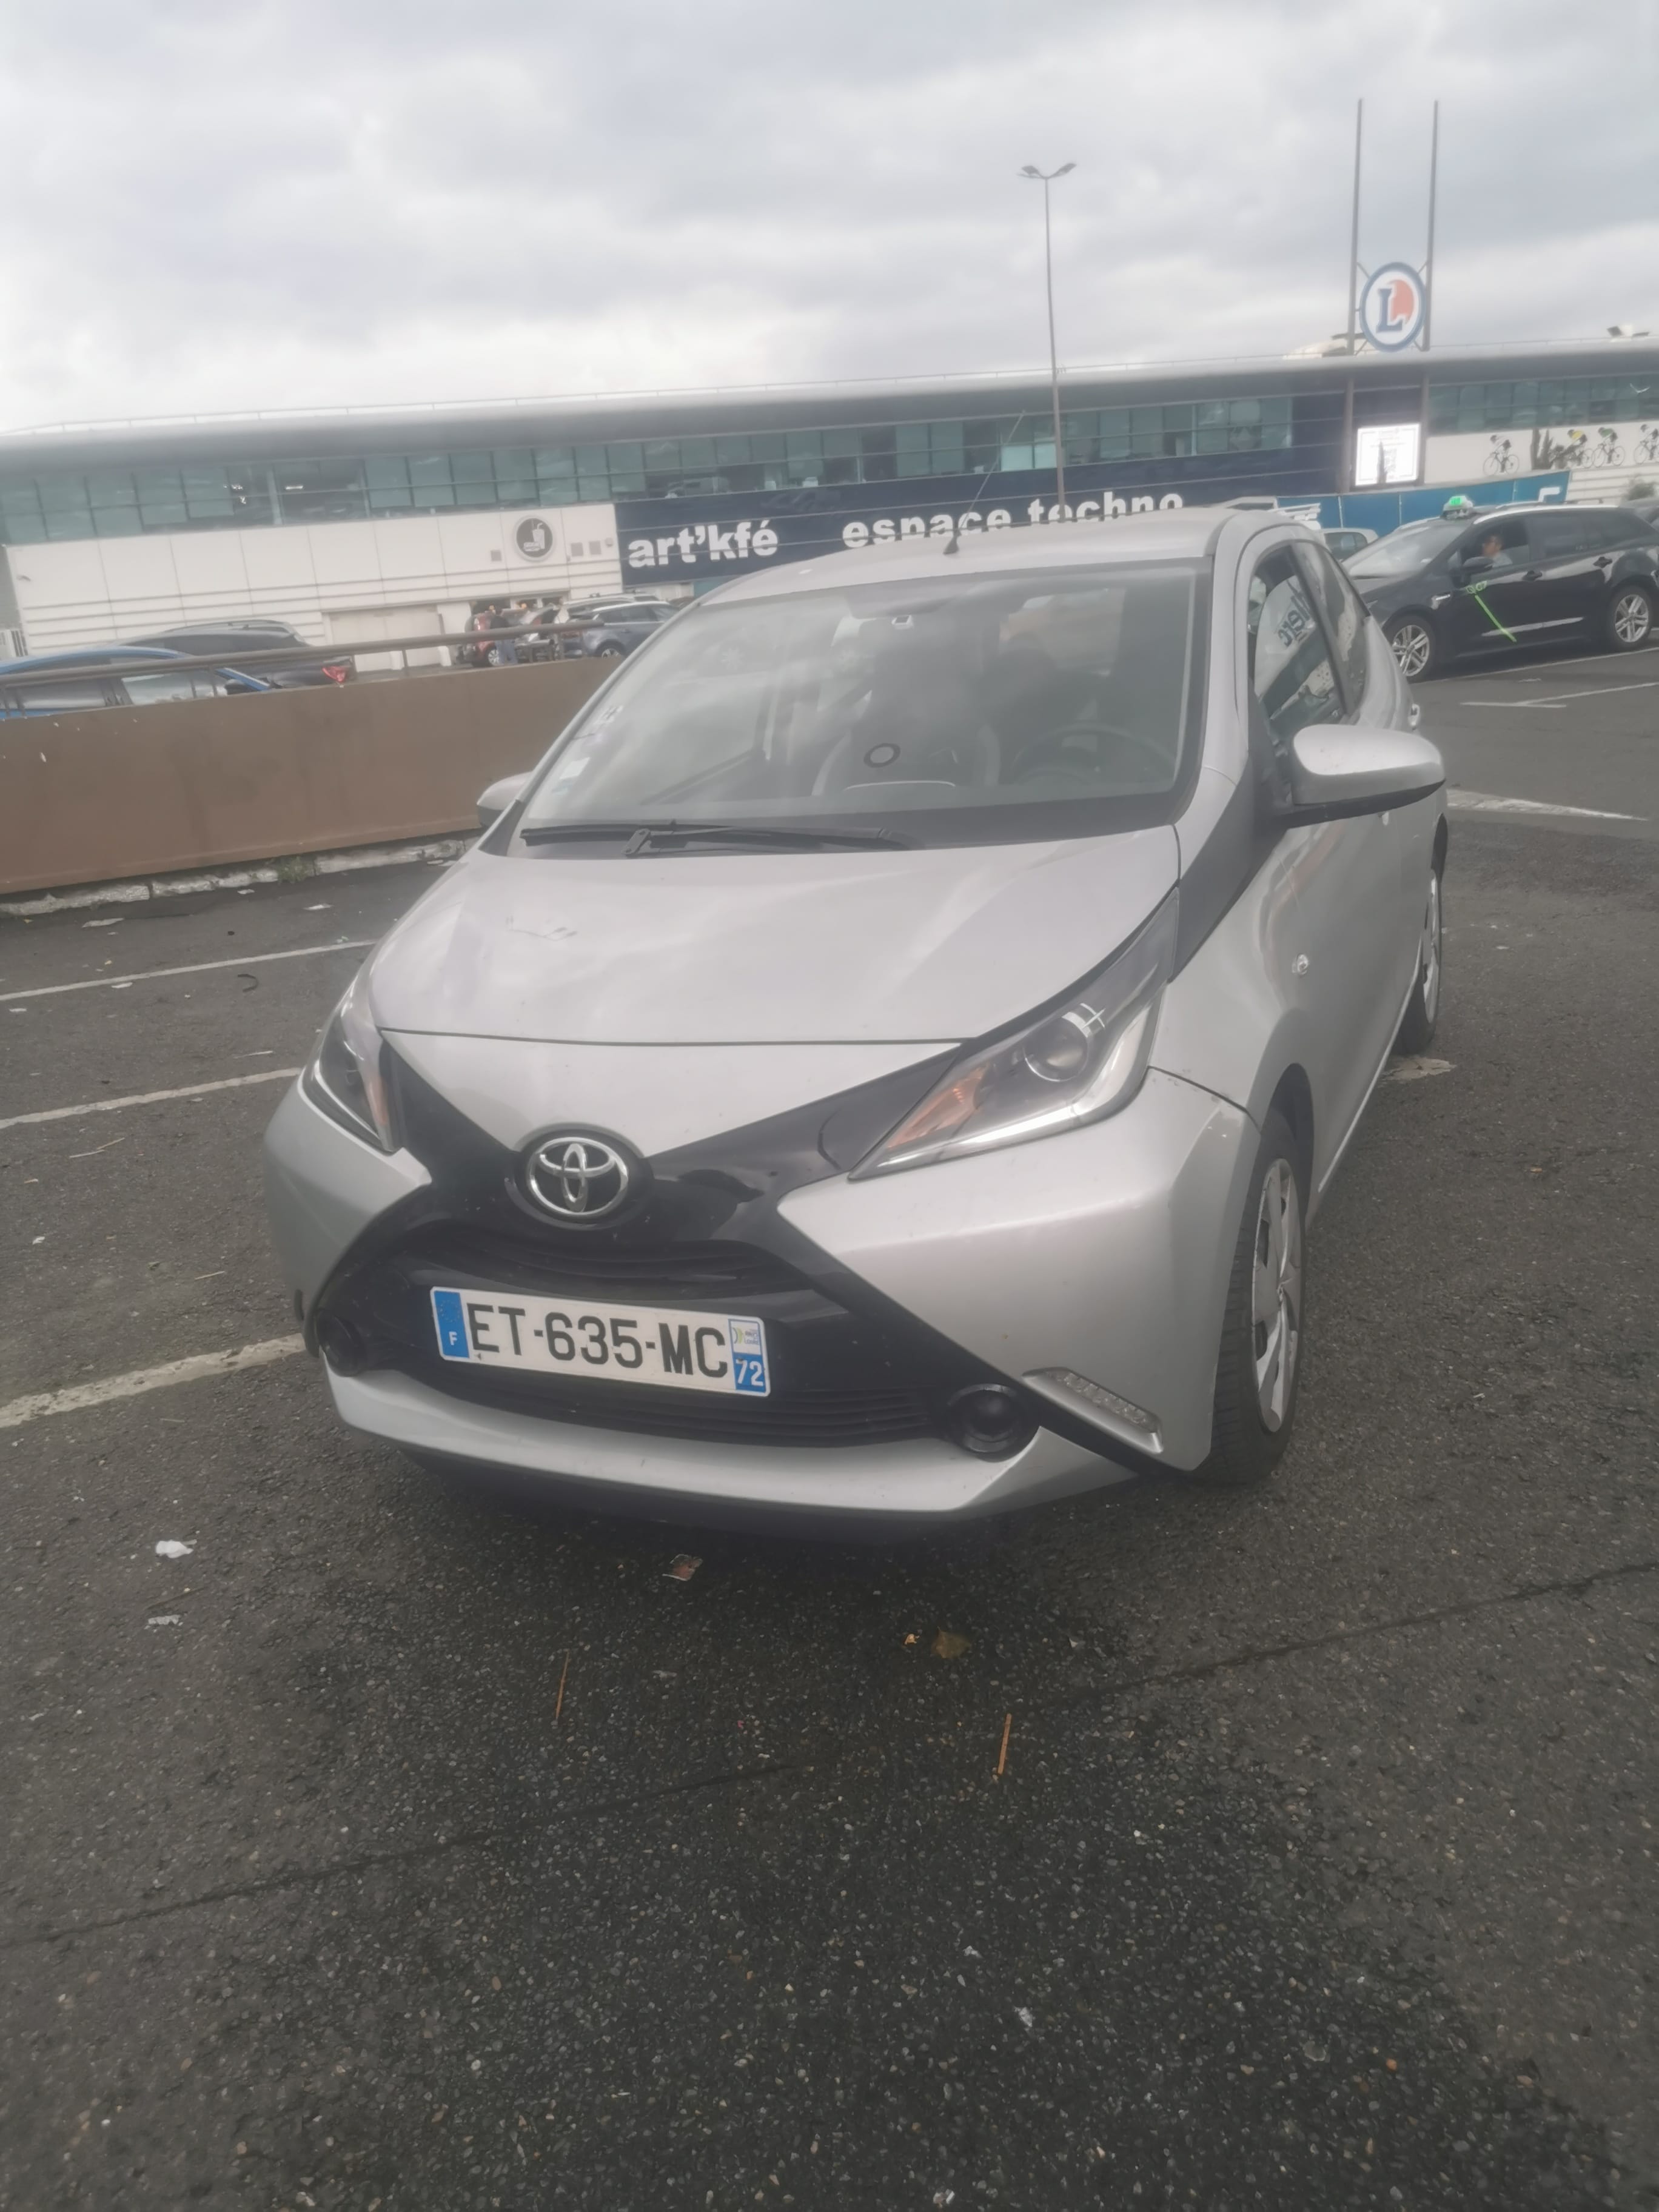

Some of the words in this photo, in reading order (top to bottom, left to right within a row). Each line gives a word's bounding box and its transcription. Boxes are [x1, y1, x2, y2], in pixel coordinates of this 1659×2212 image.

[1376, 288, 1404, 333] L
[448, 1330, 458, 1346] F
[466, 1302, 728, 1378] ET-635-MC
[736, 1358, 764, 1387] 72
